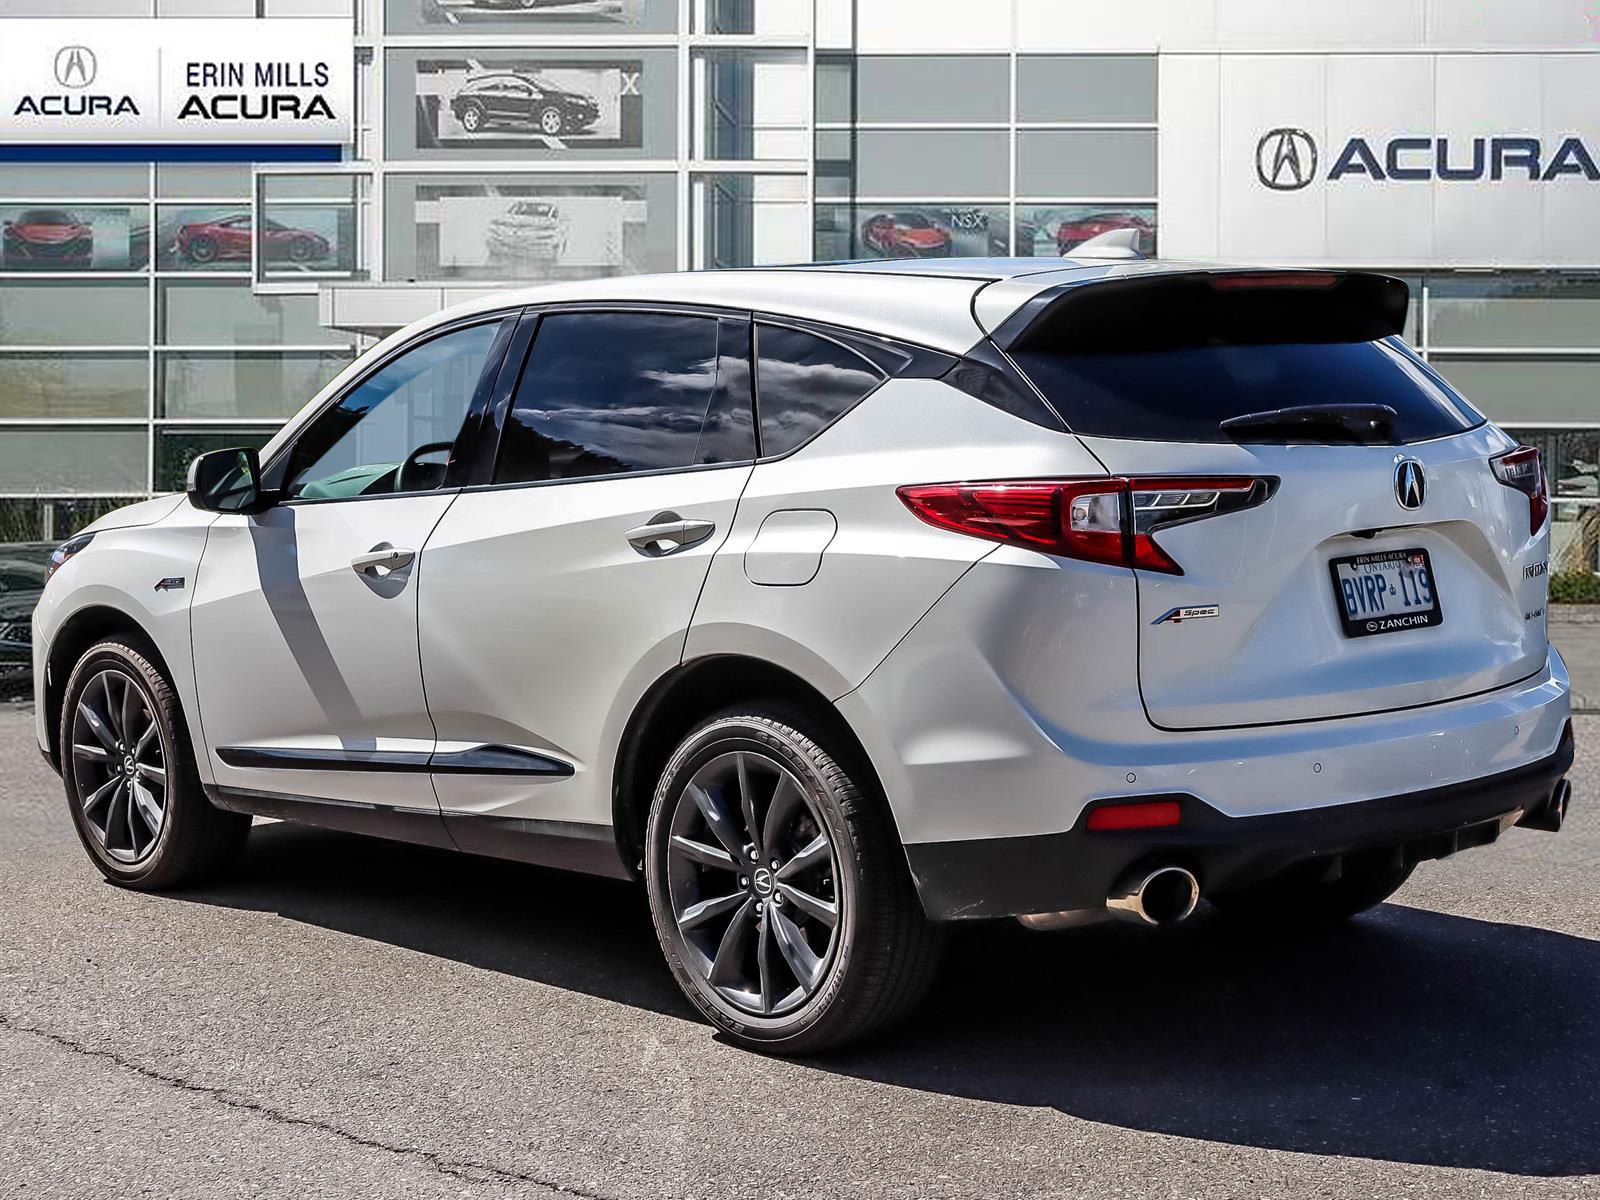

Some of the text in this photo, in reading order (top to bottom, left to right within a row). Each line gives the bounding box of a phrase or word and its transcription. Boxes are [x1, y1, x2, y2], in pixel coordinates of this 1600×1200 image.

[186, 62, 329, 87] ERIN MILLS
[14, 96, 140, 116] ACURA
[177, 95, 336, 120] ACURA
[1327, 138, 1600, 181] ACURA
[1356, 556, 1371, 565] ERIN
[1371, 554, 1387, 563] MILLS
[1387, 552, 1407, 561] ACURA
[1342, 569, 1433, 616] BVRP 119
[1380, 615, 1429, 630] ZANCHIN
